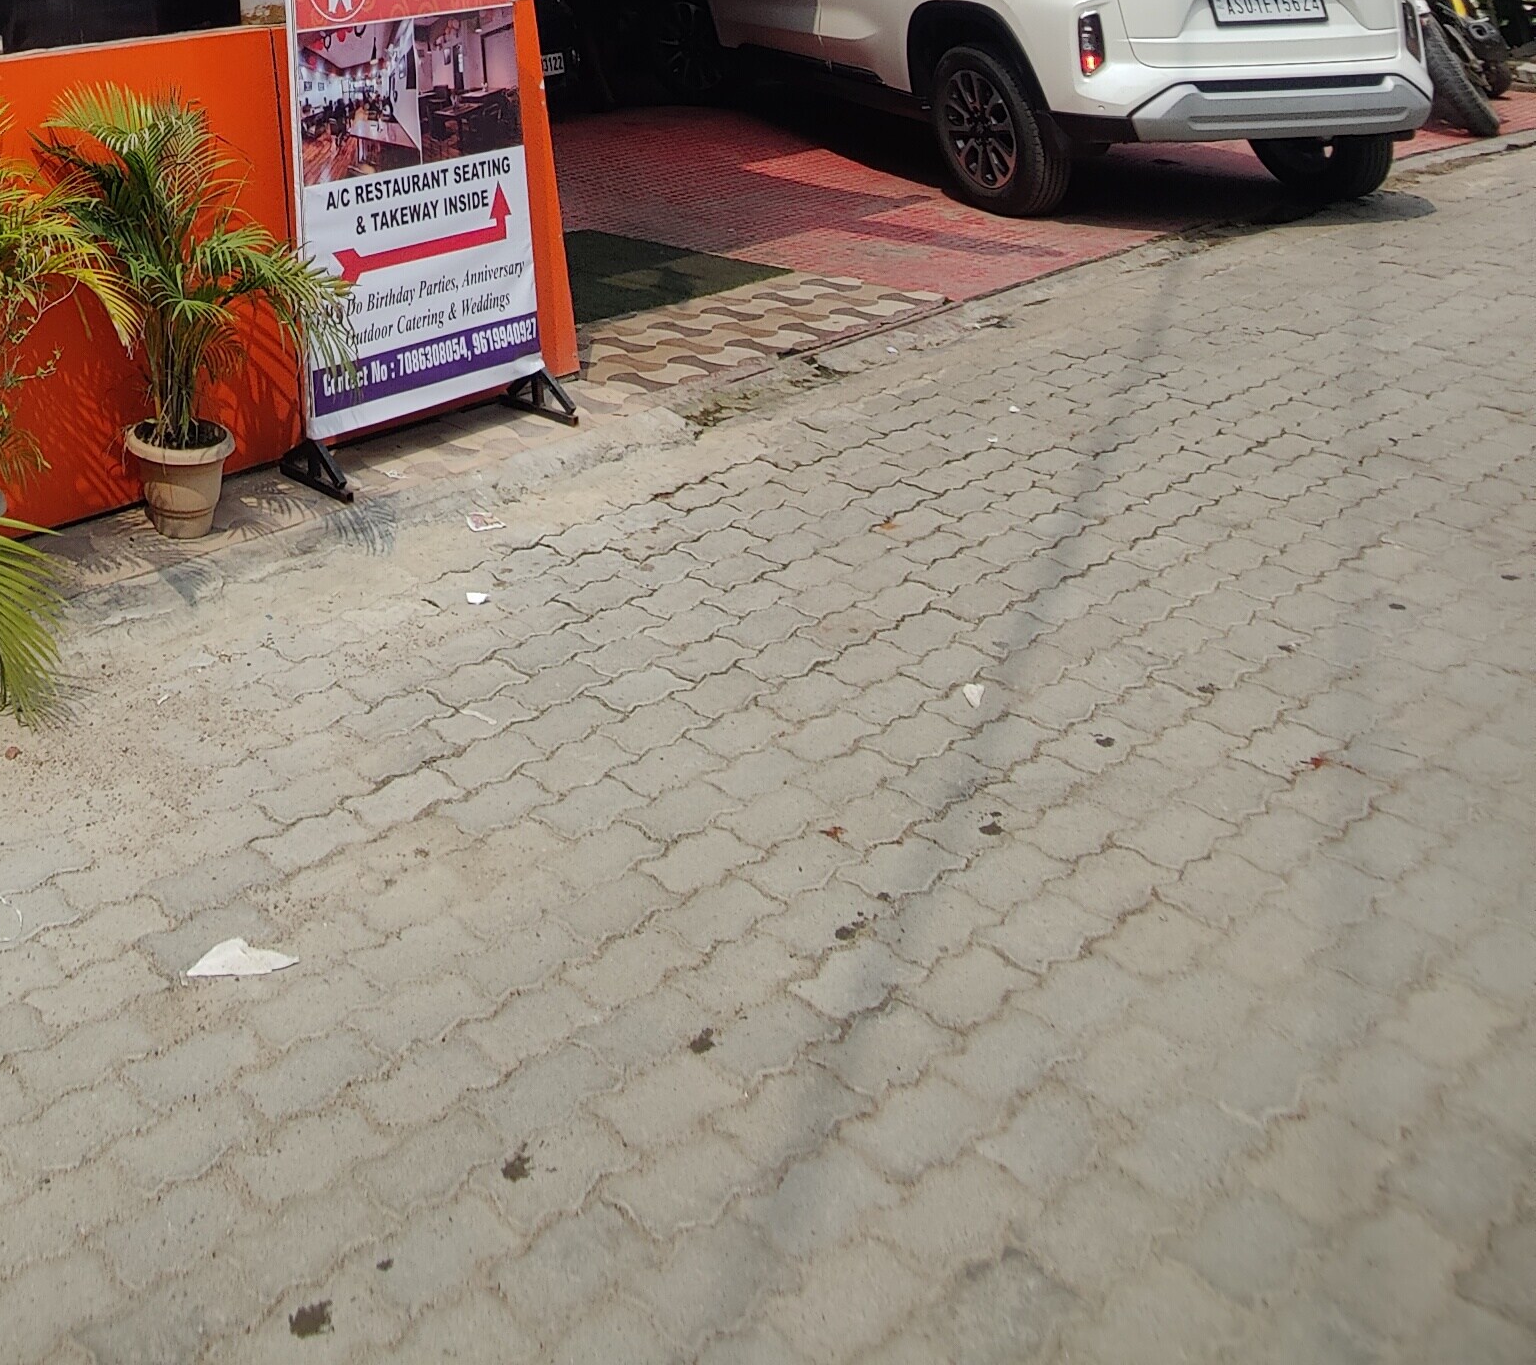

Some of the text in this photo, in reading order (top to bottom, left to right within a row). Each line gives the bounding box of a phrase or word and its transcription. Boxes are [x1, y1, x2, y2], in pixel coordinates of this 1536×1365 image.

[326, 156, 512, 211] A/C RESTAURANT SEATING
[356, 189, 490, 235] & TAKEWAY INSIDE
[366, 286, 416, 312] Birthday
[418, 274, 460, 300] Parties,
[462, 260, 526, 289] Anniversary
[346, 290, 512, 347] Outdoor Catering & Weddings
[323, 365, 369, 397] Contct
[371, 359, 388, 384] No
[397, 335, 472, 377] 7086308054,
[471, 317, 537, 356] 9619940927
